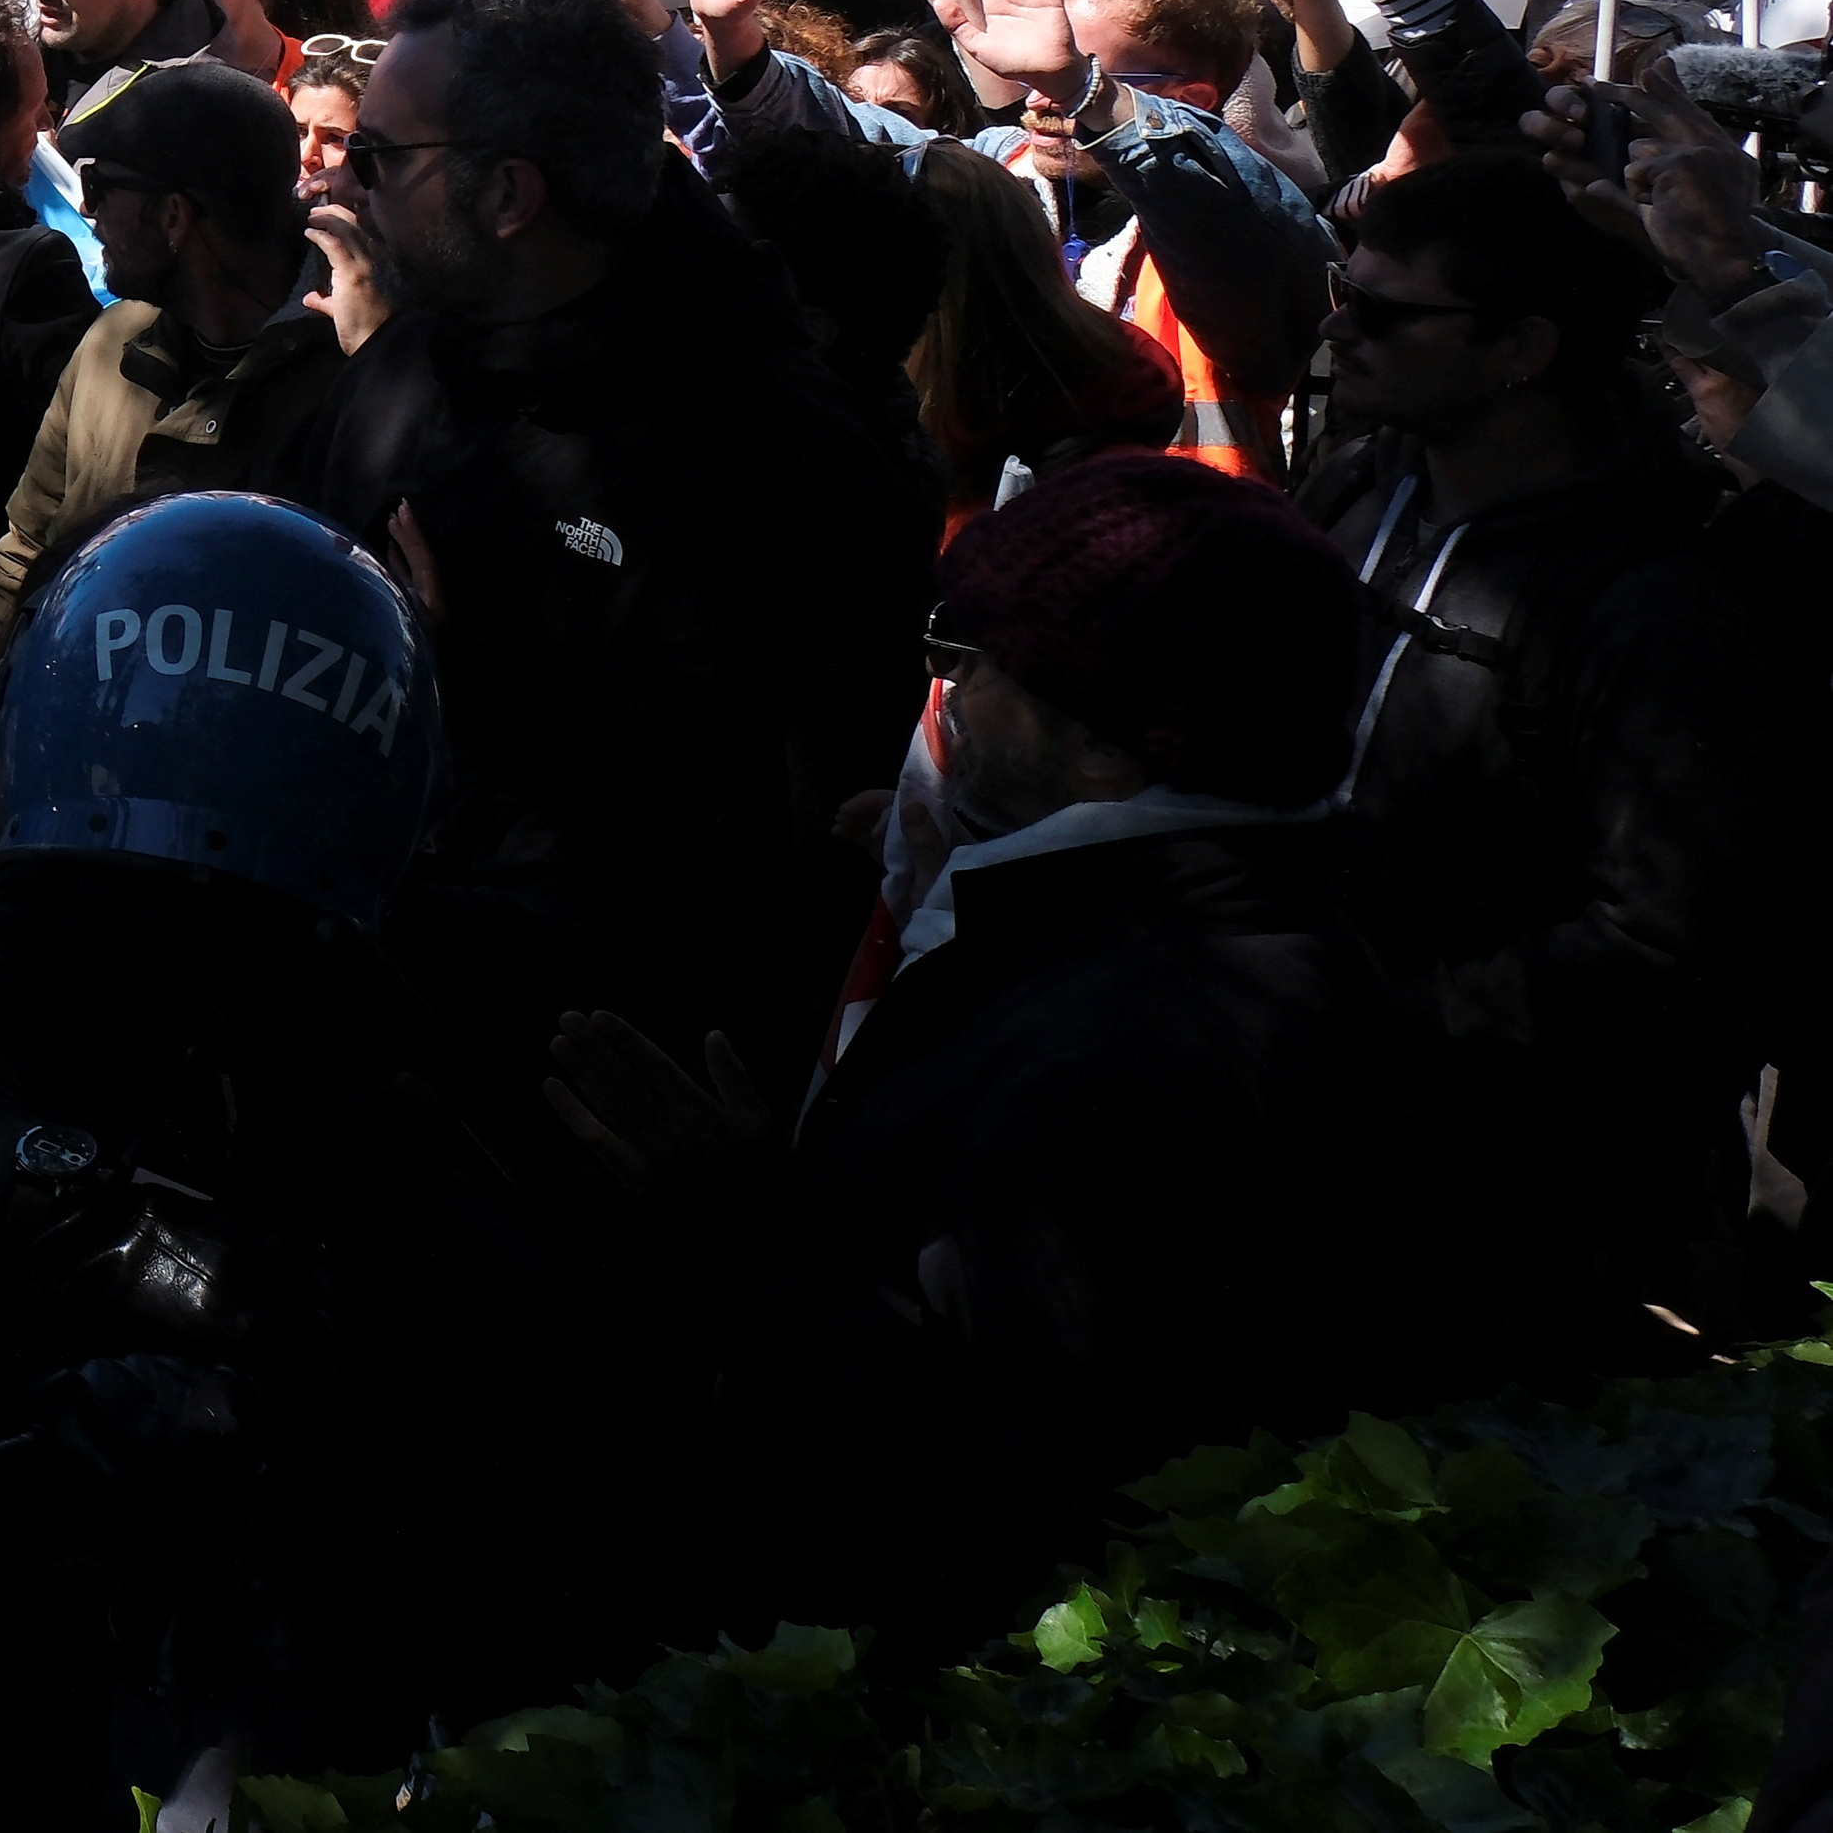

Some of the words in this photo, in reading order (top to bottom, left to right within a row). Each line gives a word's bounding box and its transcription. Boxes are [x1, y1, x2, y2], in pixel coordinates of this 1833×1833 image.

[555, 520, 600, 547] NORTH
[580, 516, 604, 537] THE
[564, 536, 598, 558] FACE
[95, 603, 401, 758] POLIZIA
